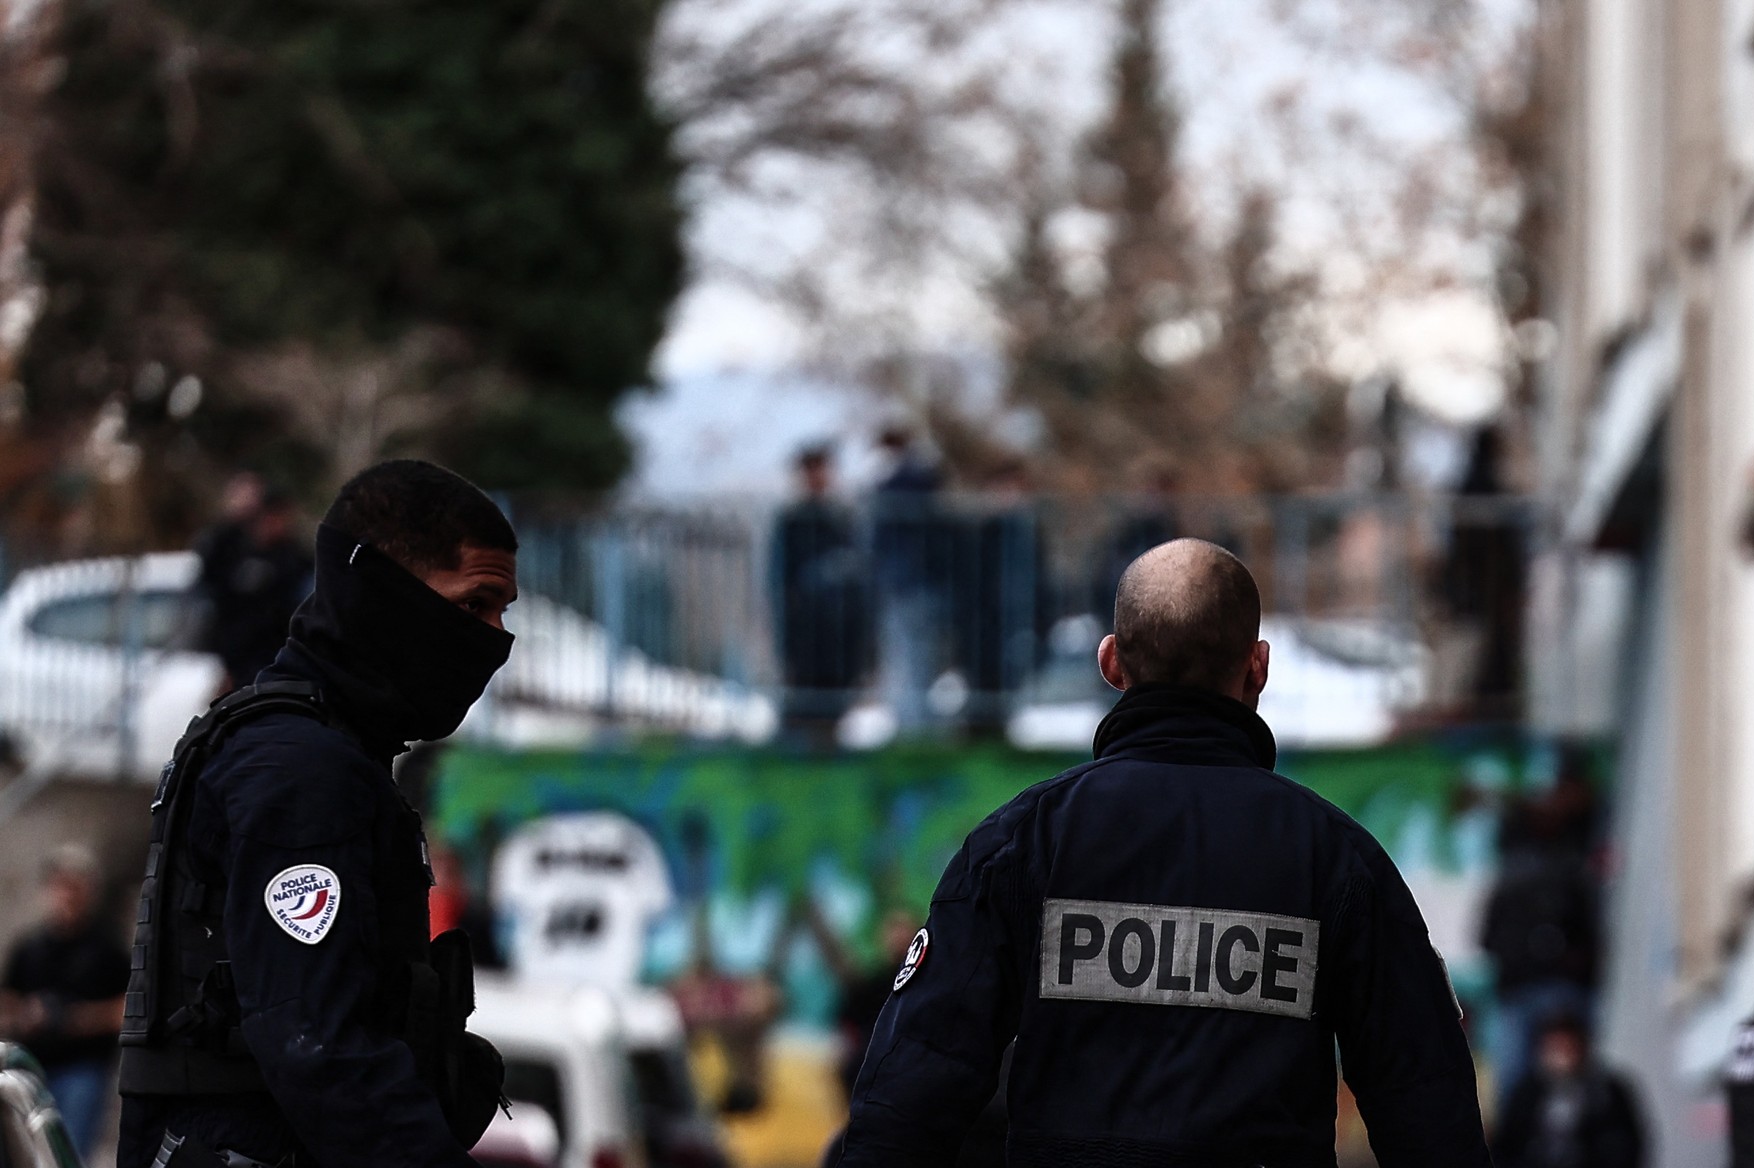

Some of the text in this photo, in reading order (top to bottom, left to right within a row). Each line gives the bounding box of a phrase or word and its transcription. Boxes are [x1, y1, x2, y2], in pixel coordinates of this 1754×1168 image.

[273, 878, 332, 902] NATIONALE
[281, 873, 317, 890] POLICE
[277, 895, 336, 939] SECURITE PUBLIQUE
[1058, 913, 1303, 1003] POLICE
